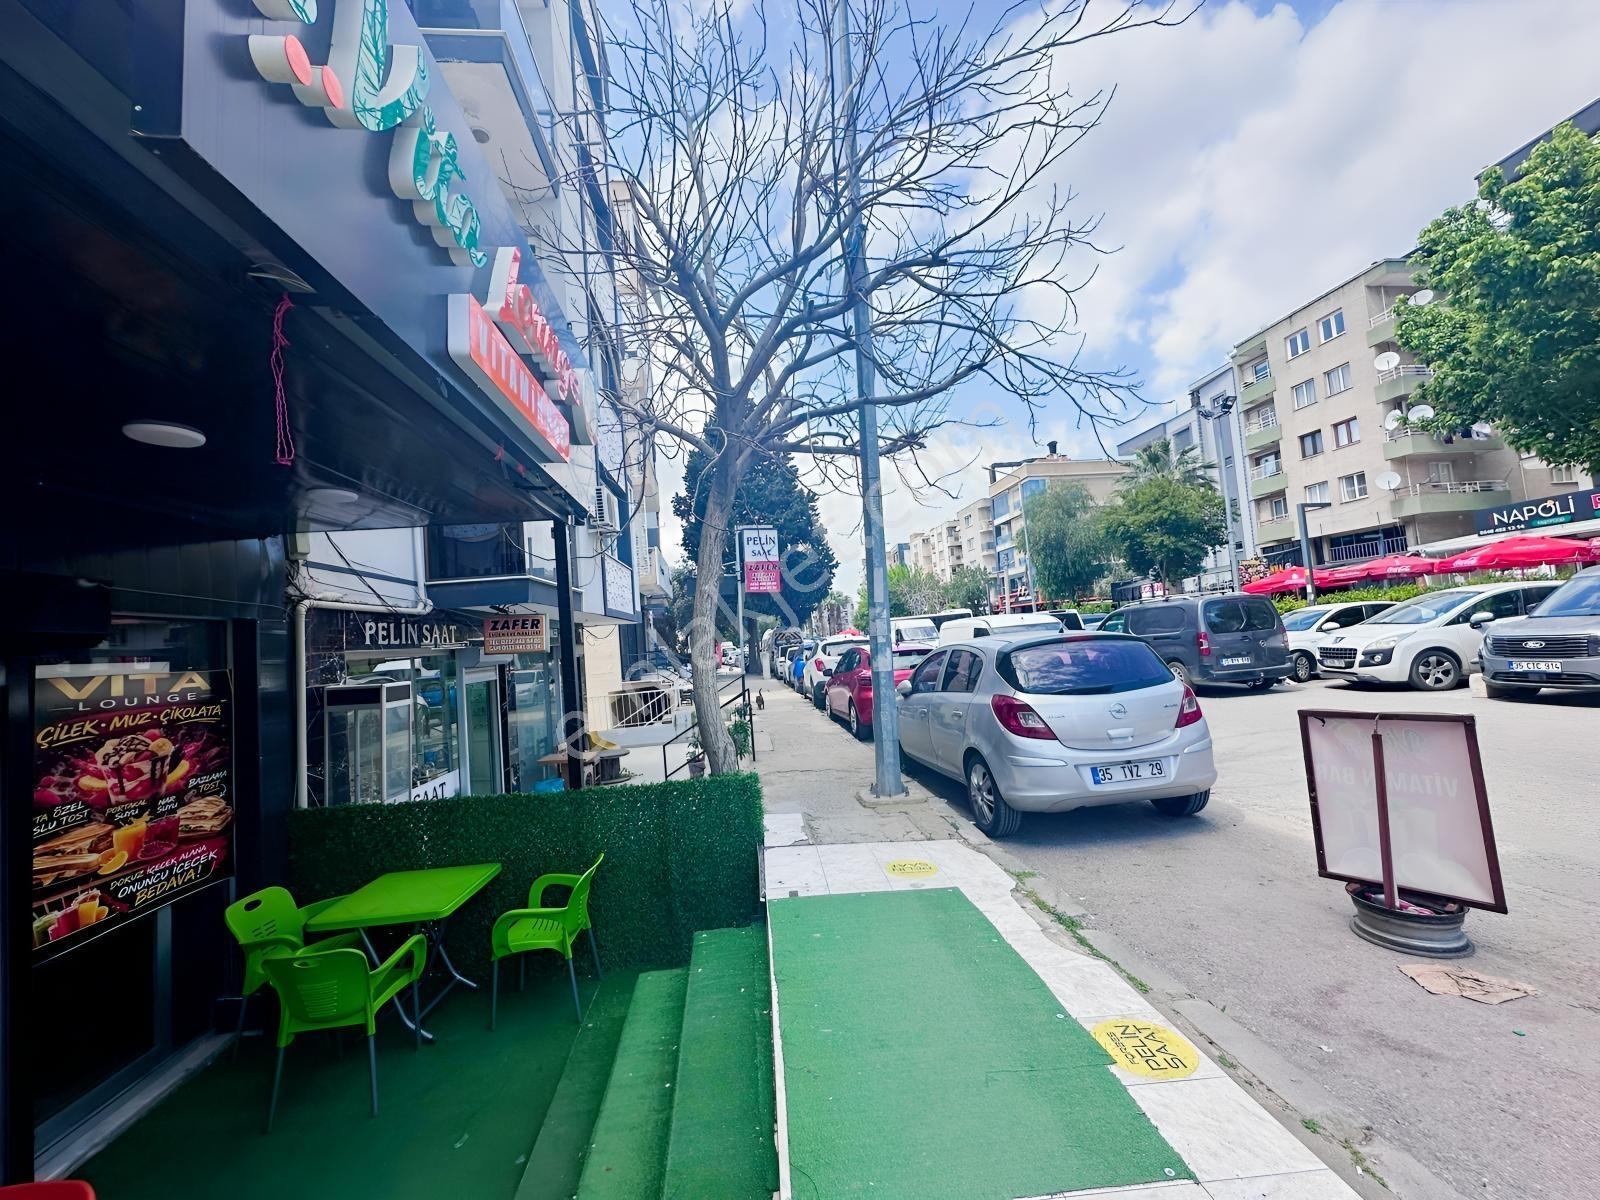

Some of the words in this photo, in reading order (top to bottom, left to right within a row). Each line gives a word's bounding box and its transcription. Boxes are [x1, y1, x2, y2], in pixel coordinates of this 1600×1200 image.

[1493, 496, 1575, 525] NAPOLİ
[746, 534, 776, 546] PELİN
[365, 618, 418, 645] PELİN
[422, 624, 457, 644] SAAT
[490, 619, 540, 631] ZAFER
[78, 692, 197, 712] LOUNGE
[36, 719, 100, 749] ÇİLEK
[109, 712, 152, 732] MUZ
[160, 704, 222, 726] ÇİKOLATA
[1099, 767, 1113, 782] 35
[1121, 764, 1142, 779] TVZ
[1149, 762, 1163, 776] 29
[199, 780, 220, 794] TOST
[52, 801, 85, 818] ÖZEL
[60, 808, 90, 826] TOST
[110, 870, 144, 891] DOKUZ
[179, 845, 206, 861] ALANA
[118, 869, 168, 898] ONUNCU
[134, 865, 202, 907] BEDAVA!
[1114, 1024, 1168, 1071] PELİN
[1132, 1024, 1188, 1069] SAAT
